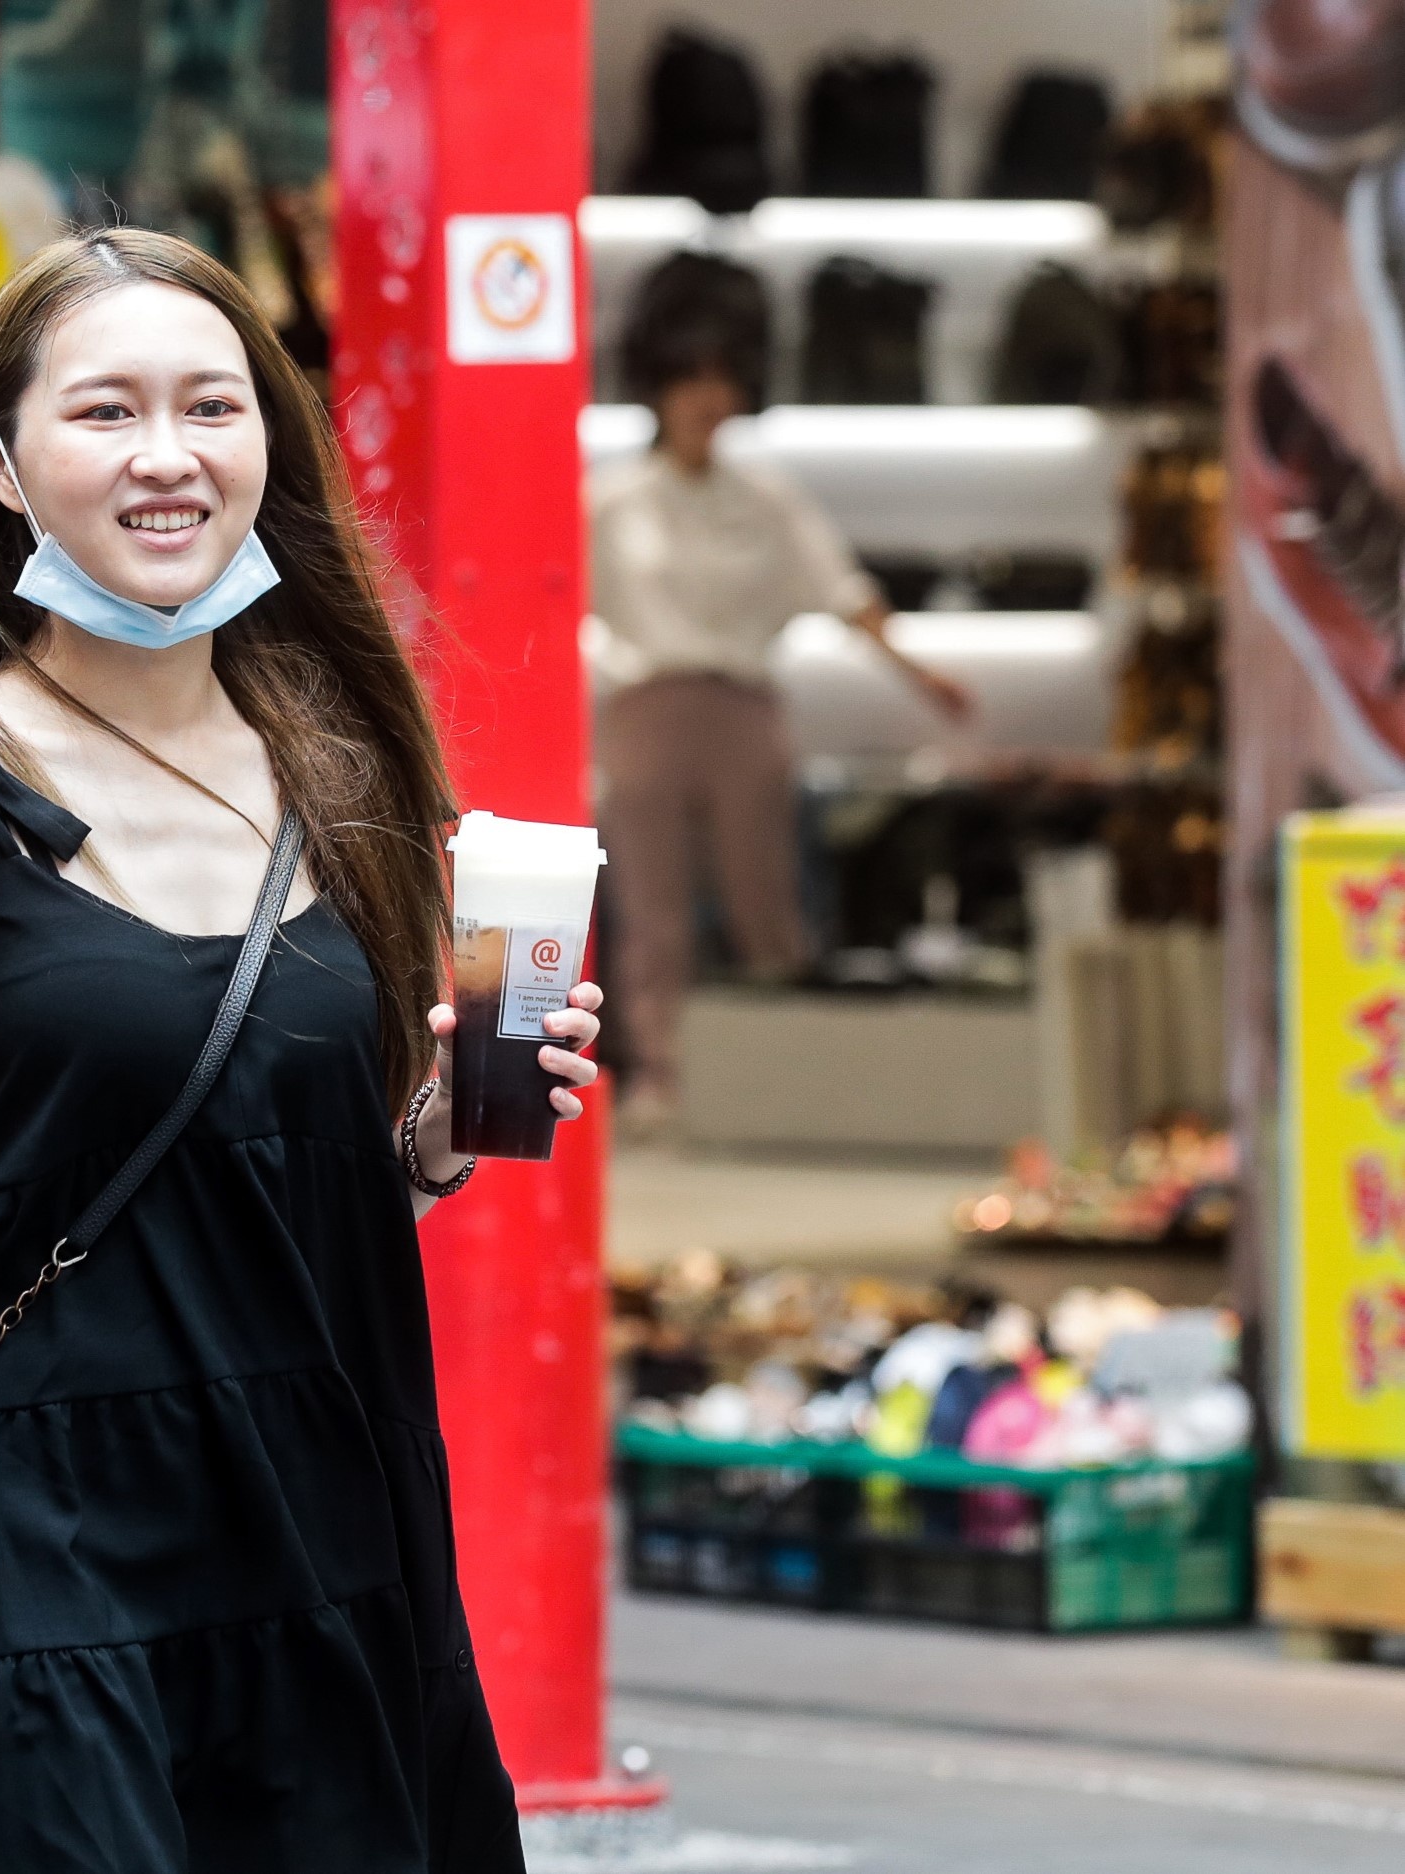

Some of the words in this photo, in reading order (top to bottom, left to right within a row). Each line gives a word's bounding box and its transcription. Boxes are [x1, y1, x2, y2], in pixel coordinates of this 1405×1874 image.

[534, 975, 542, 983] At
[524, 1005, 539, 1013] just
[519, 1016, 538, 1024] what
